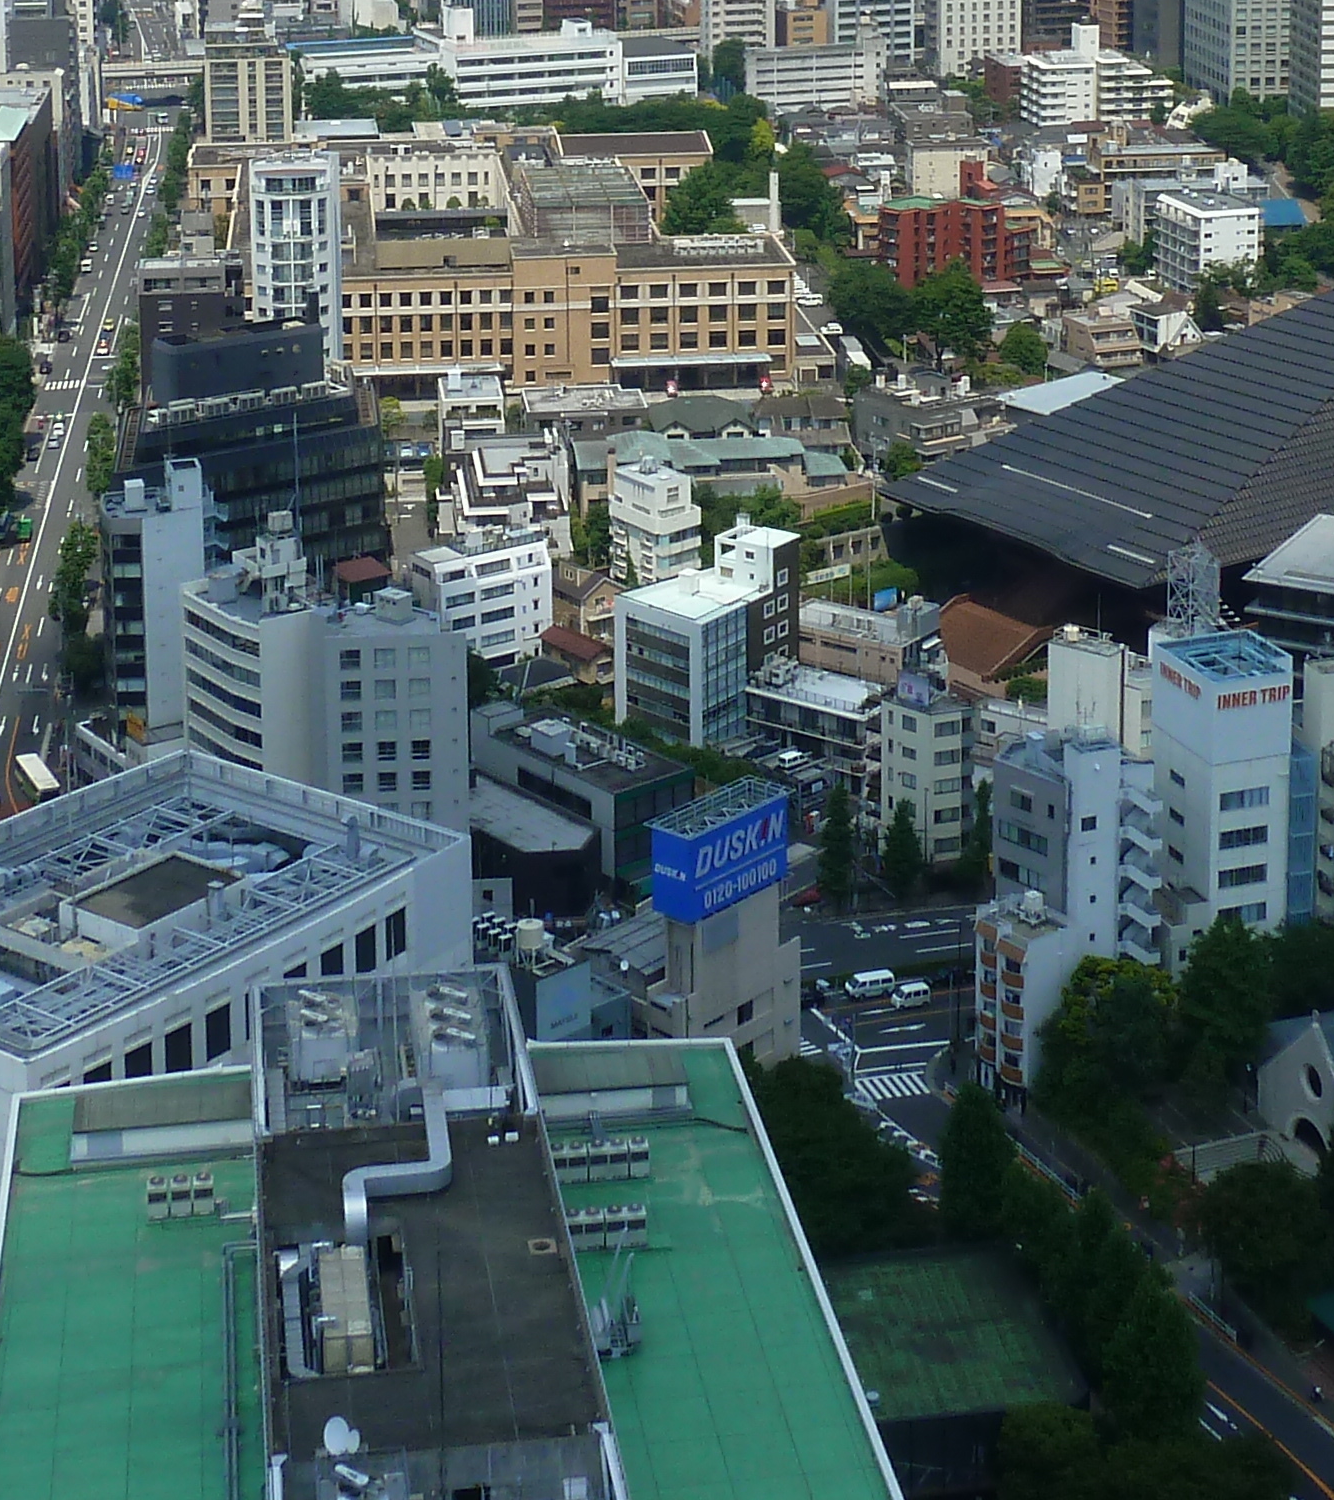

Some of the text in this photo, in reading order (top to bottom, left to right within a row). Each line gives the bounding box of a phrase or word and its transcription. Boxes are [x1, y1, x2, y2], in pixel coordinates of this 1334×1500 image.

[1160, 661, 1202, 700] INNER TRIP
[1217, 685, 1291, 710] INNER TRIP
[704, 858, 777, 910] 0120-100100
